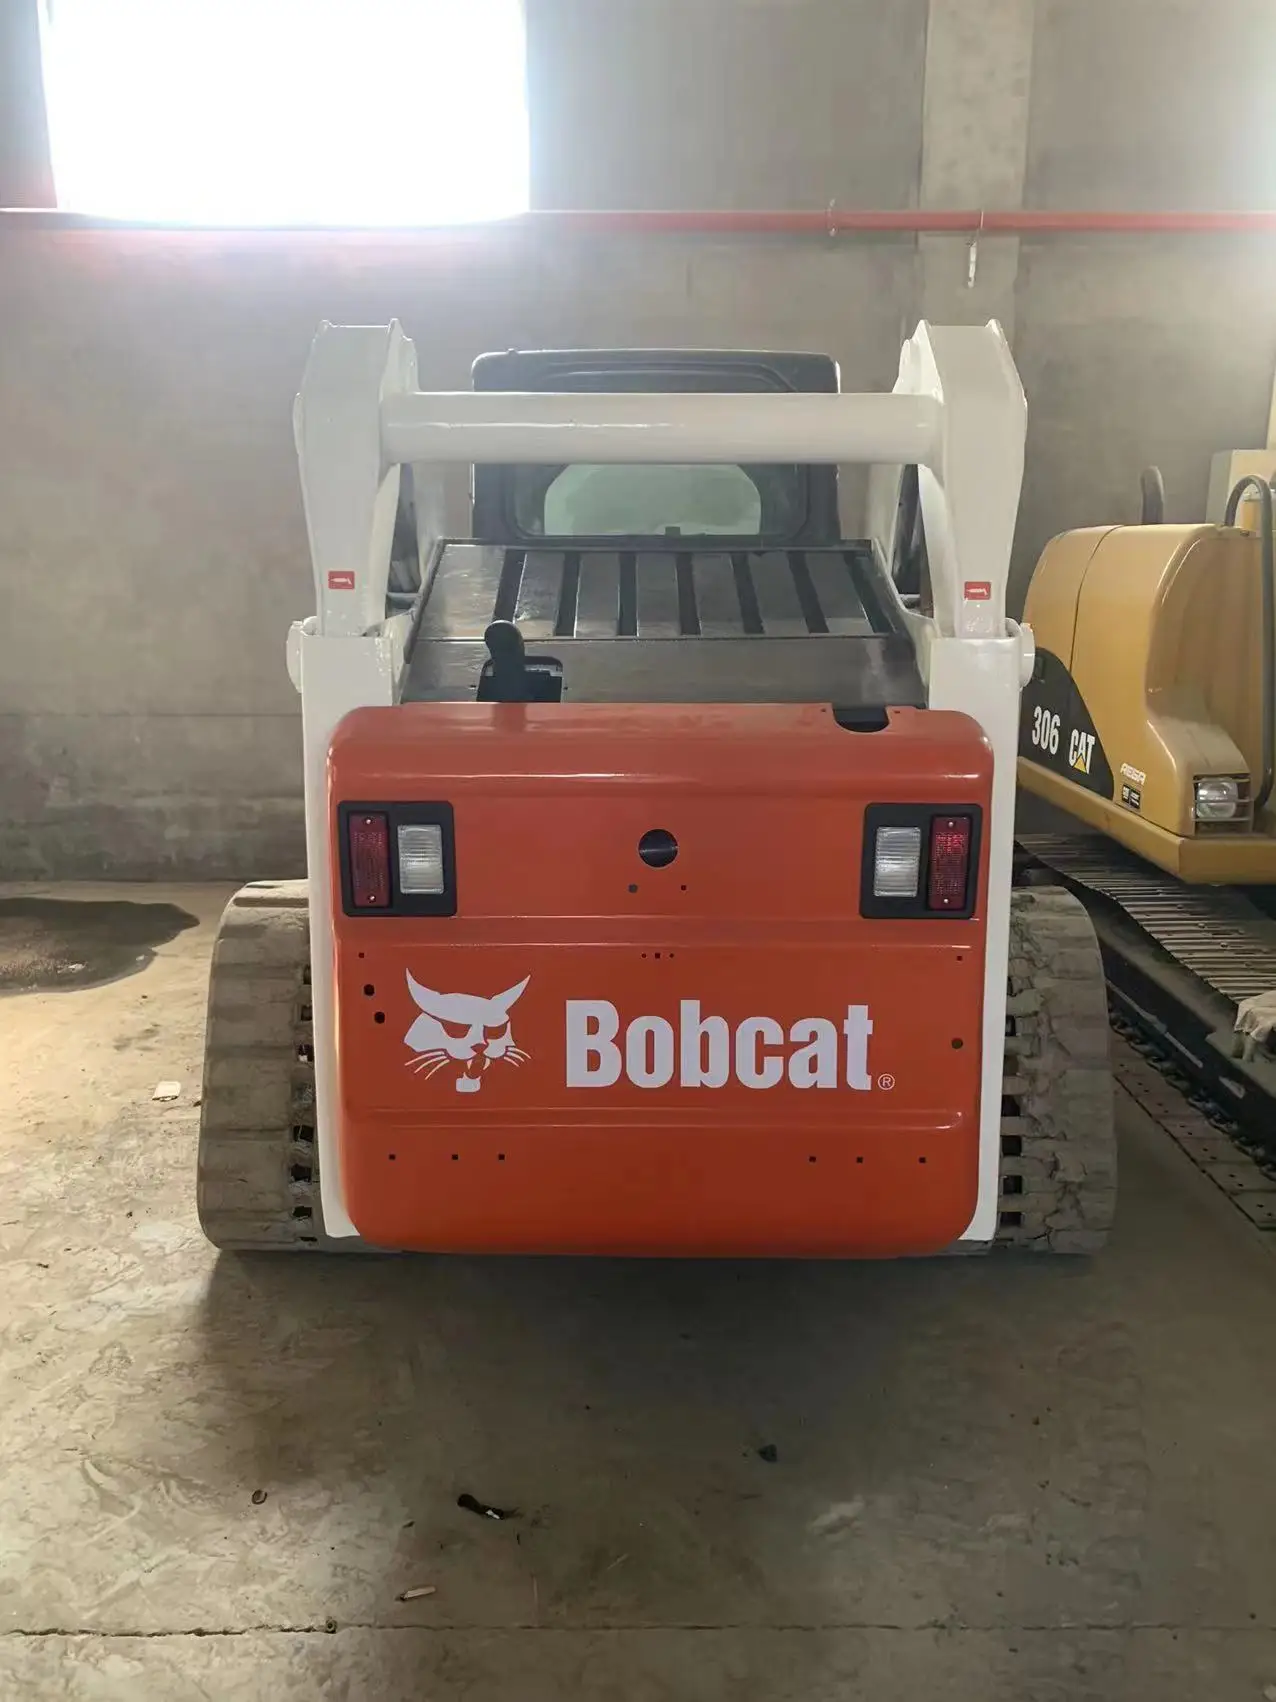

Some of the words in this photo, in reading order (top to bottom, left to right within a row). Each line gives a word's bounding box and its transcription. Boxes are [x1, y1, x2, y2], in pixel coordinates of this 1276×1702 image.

[1032, 706, 1061, 755] 306
[1069, 729, 1096, 774] CAT
[566, 999, 873, 1090] Bobcat
